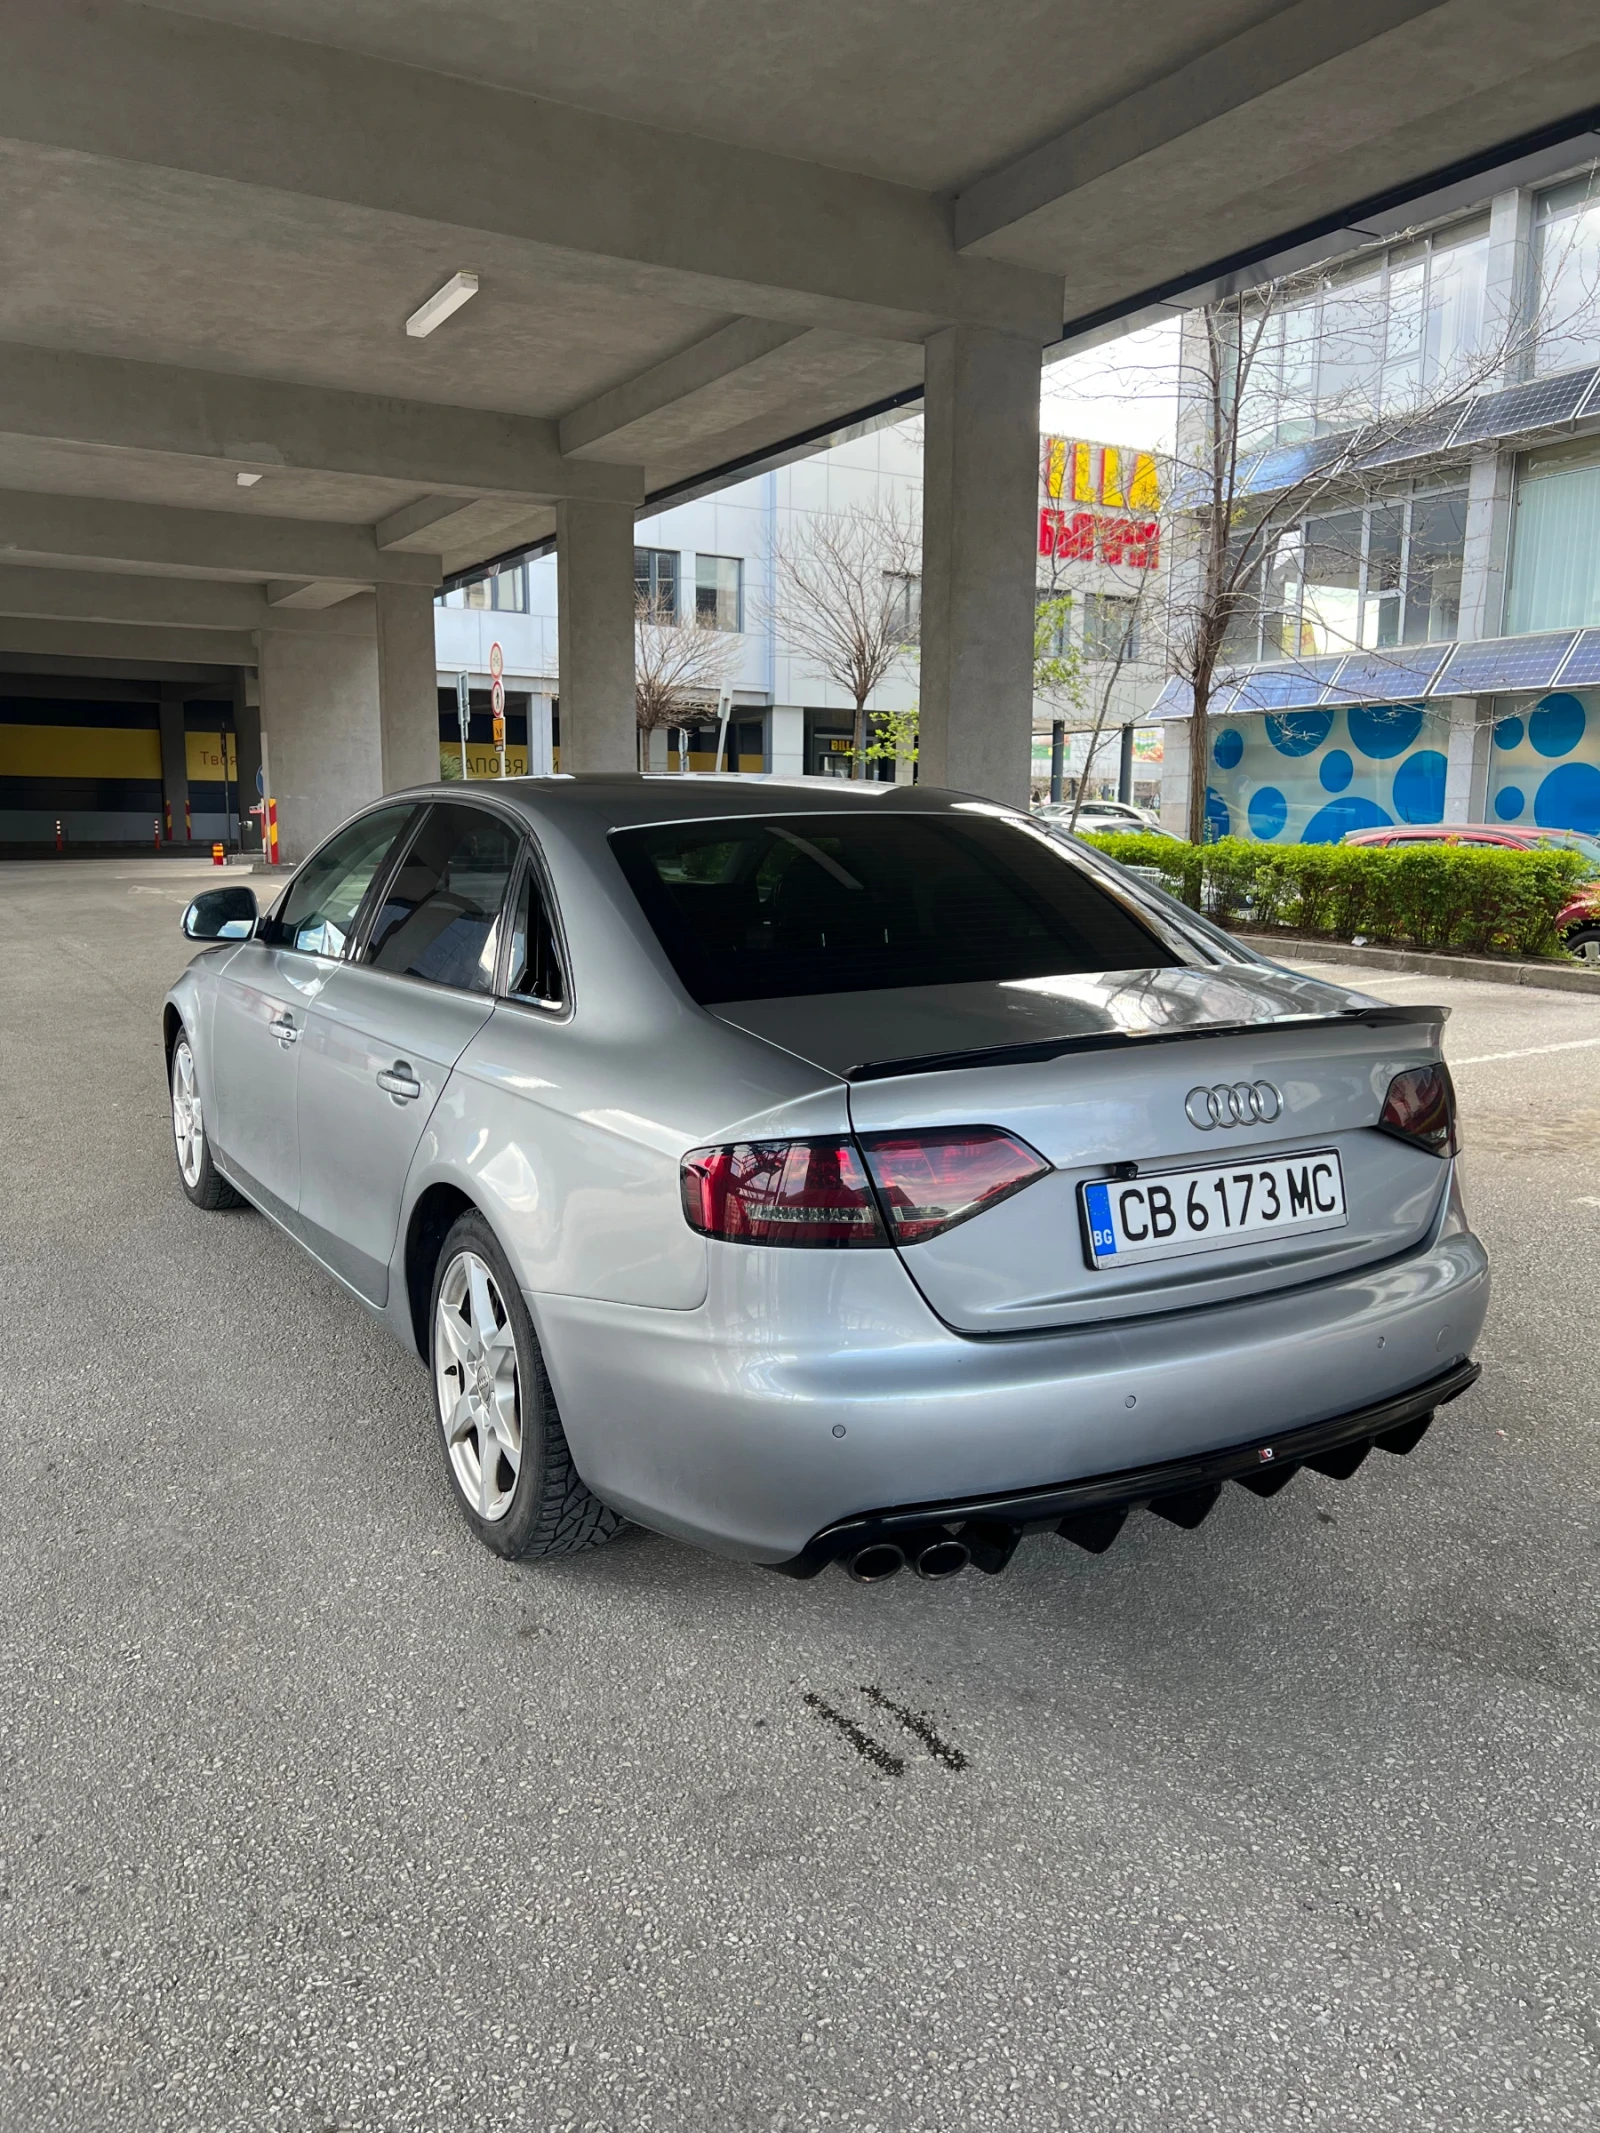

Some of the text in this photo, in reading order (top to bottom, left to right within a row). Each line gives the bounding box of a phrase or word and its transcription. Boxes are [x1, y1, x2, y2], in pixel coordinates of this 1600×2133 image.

[1046, 438, 1161, 513] ILLA
[830, 739, 852, 752] BILL
[1118, 1163, 1337, 1242] CB 6173 MC
[1092, 1229, 1113, 1247] BG
